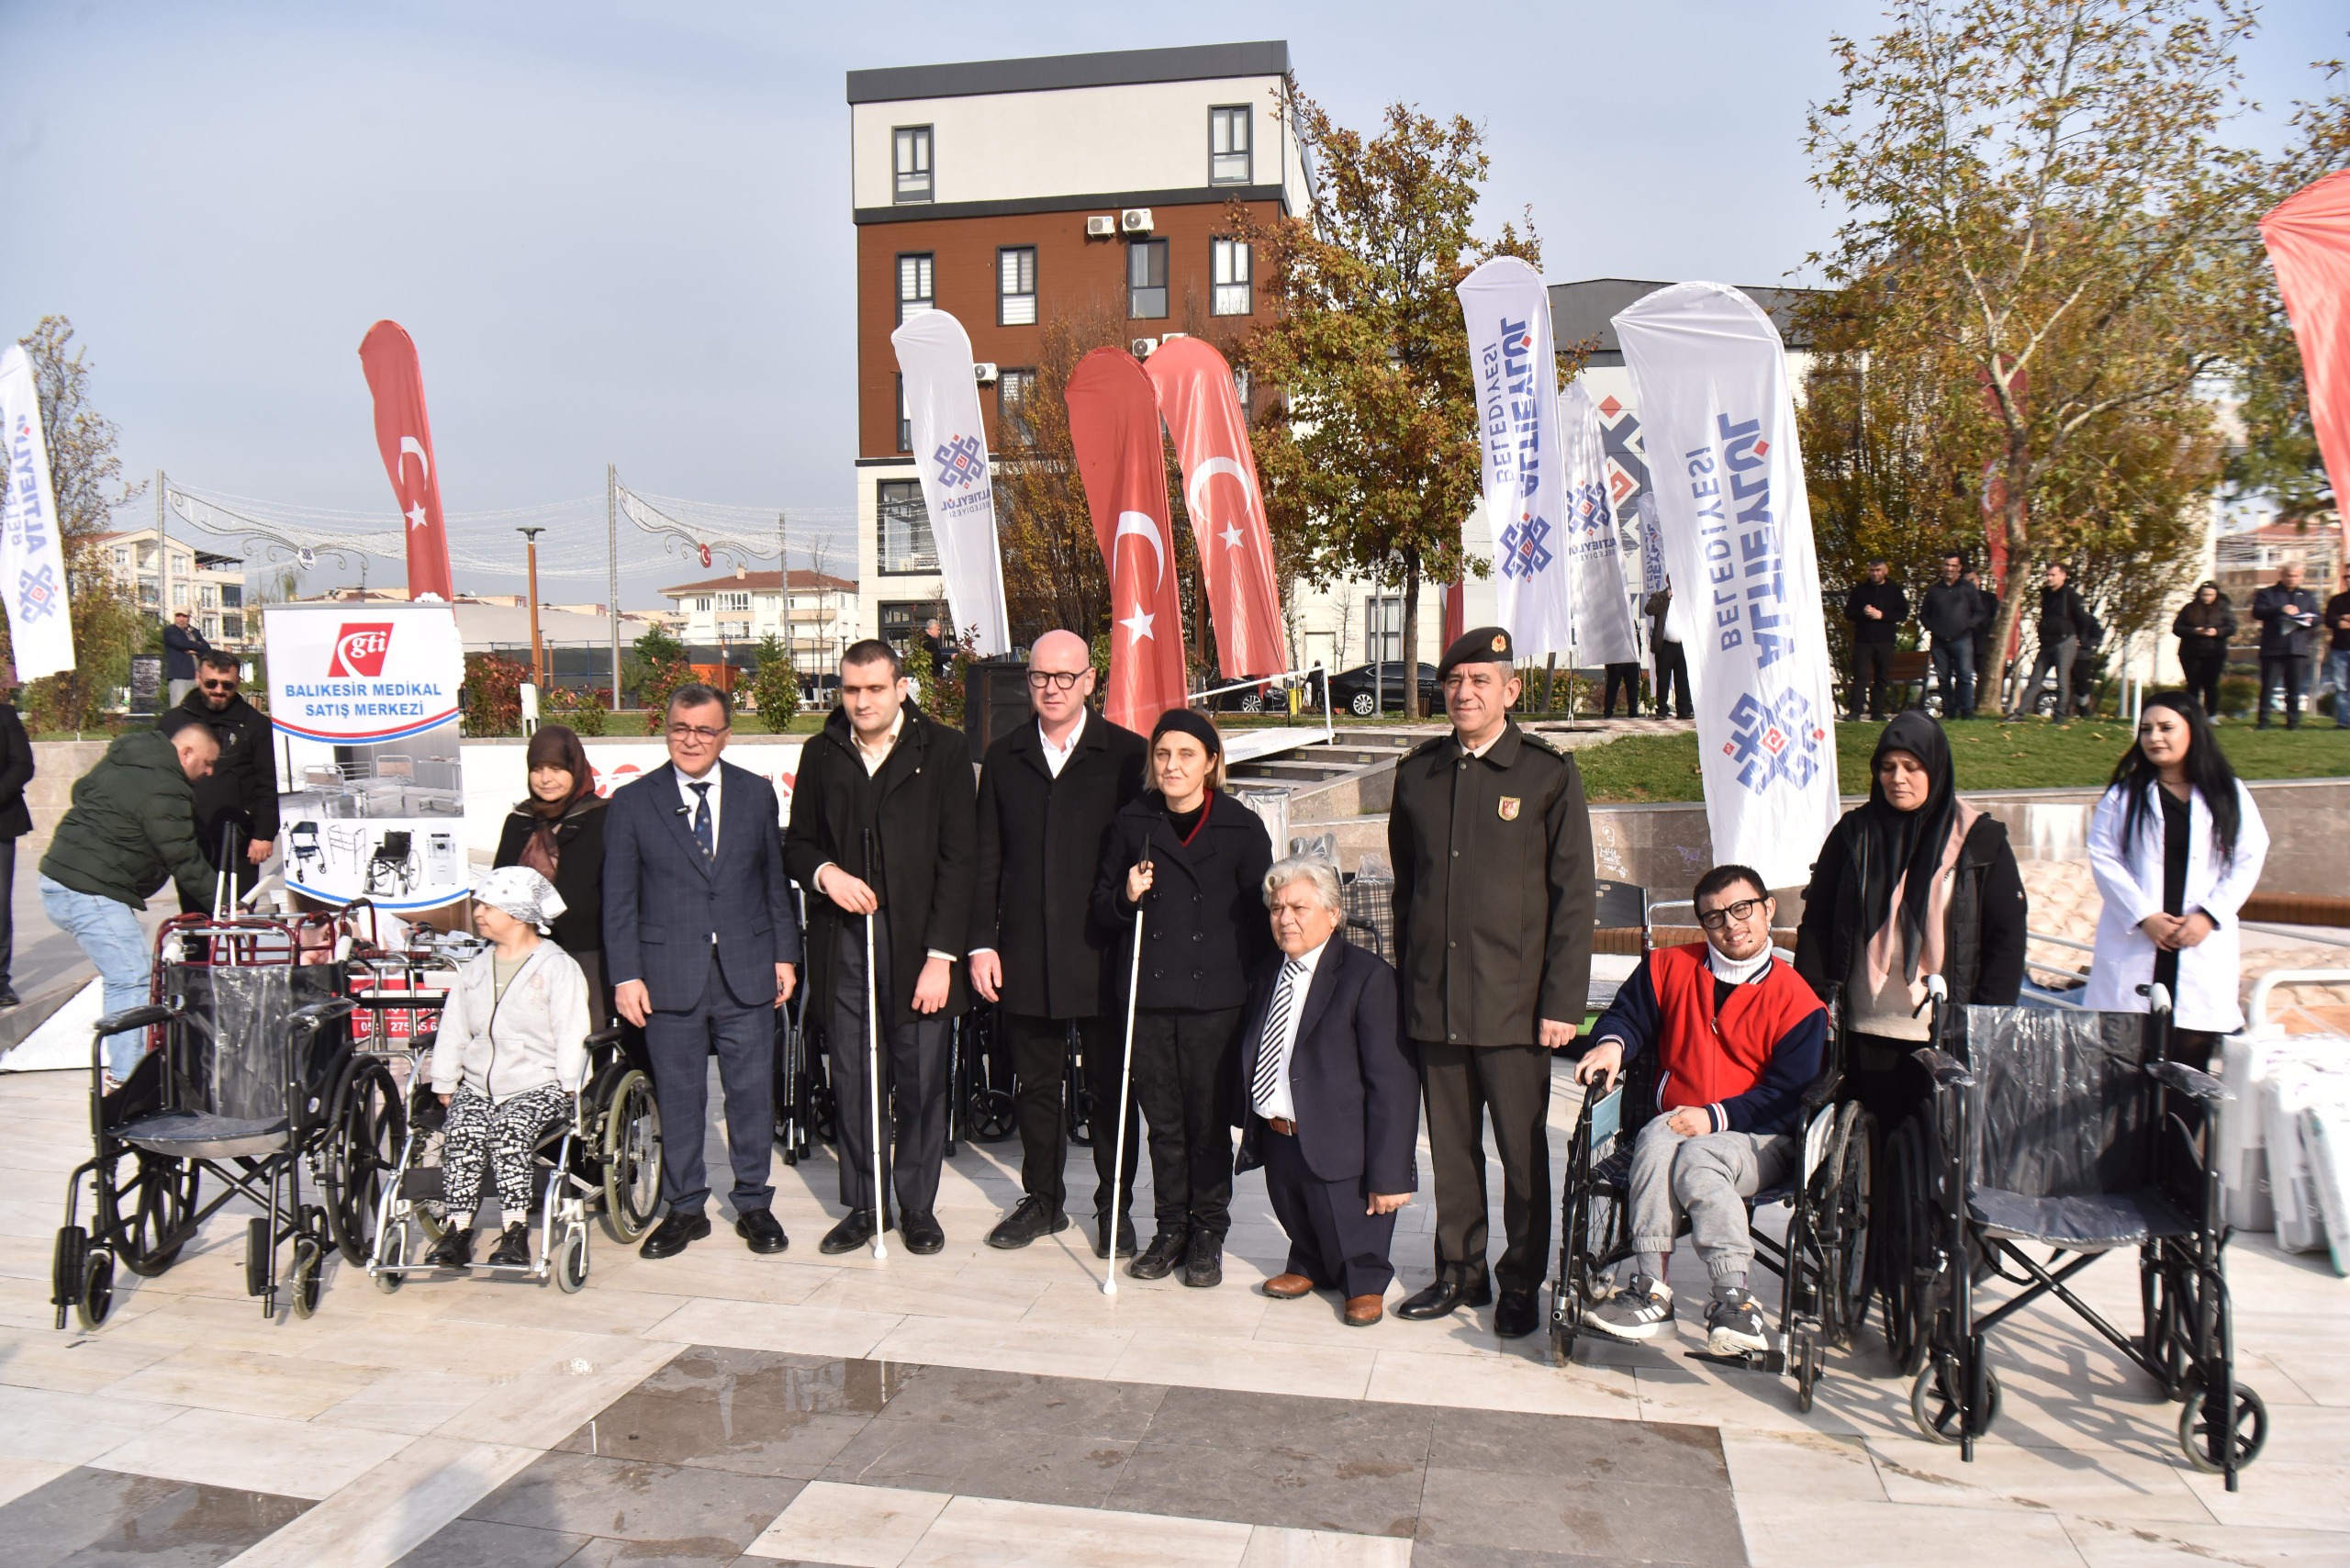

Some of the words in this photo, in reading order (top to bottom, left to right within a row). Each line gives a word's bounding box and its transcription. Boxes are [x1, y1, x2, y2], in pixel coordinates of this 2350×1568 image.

[350, 632, 386, 658] gti
[285, 681, 367, 697] BALIKESİR
[373, 680, 442, 696] MEDİKAL
[306, 703, 350, 719] SATIŞ
[355, 700, 424, 716] MERKEZİ
